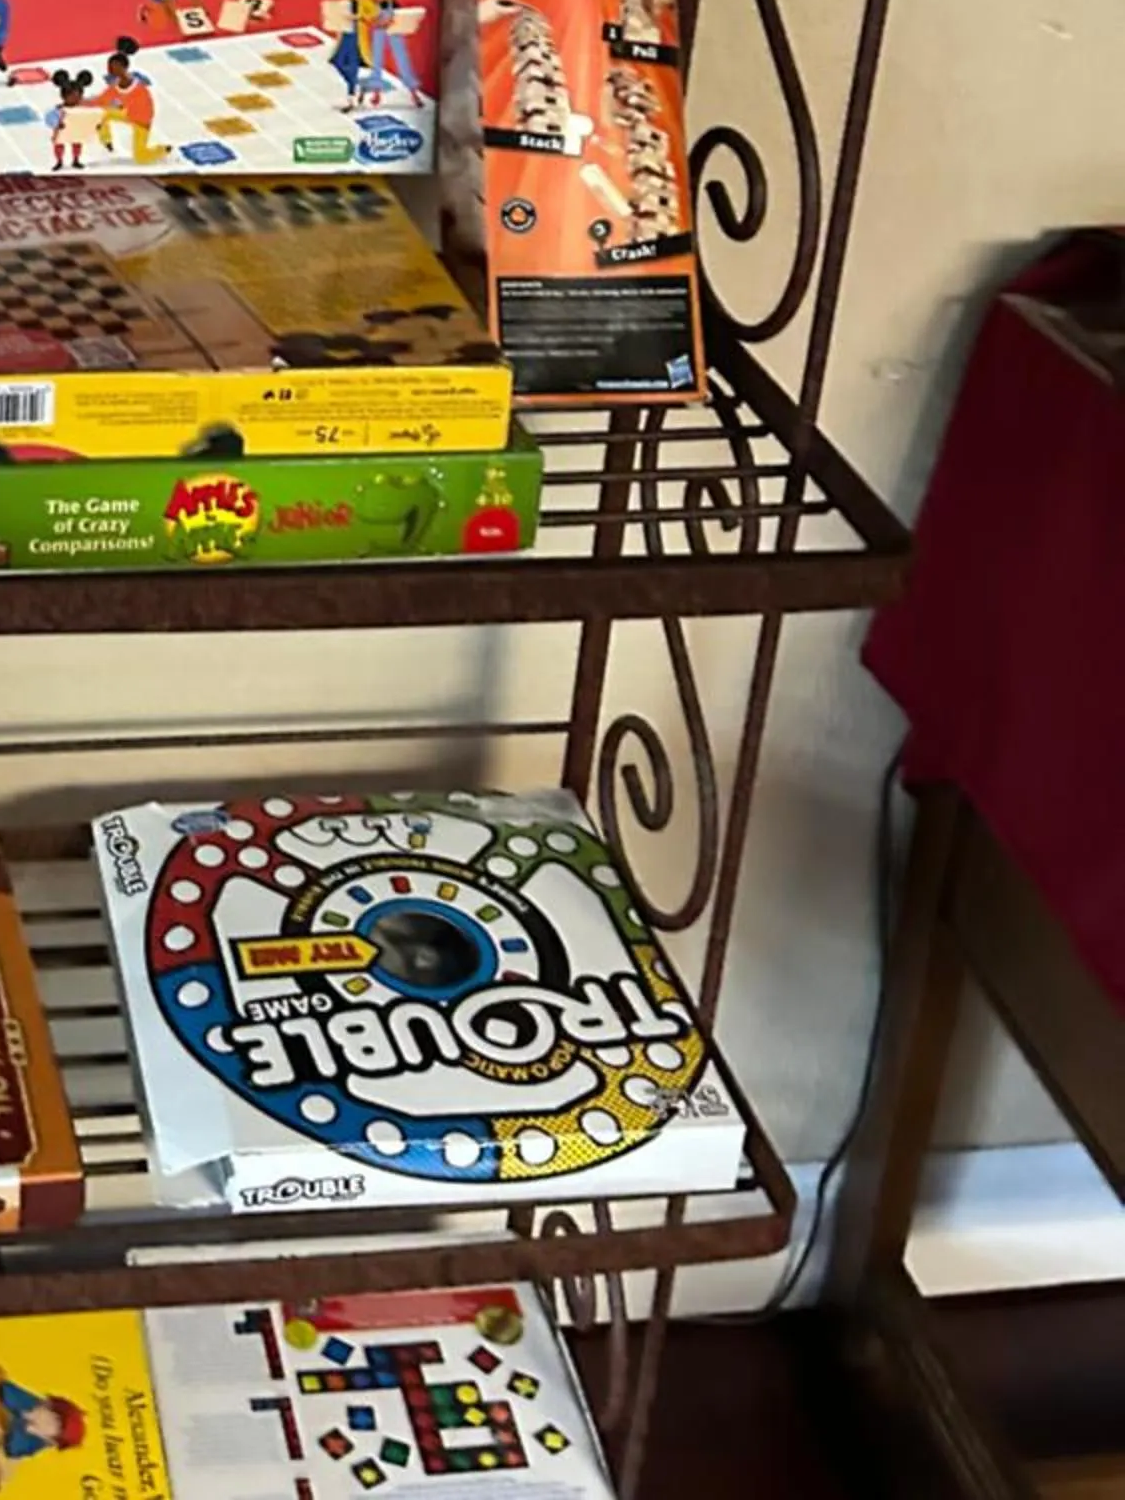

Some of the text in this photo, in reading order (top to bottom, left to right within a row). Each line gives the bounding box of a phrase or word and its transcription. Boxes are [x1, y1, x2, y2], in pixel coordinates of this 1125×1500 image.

[45, 498, 140, 515] The Game
[53, 517, 131, 535] of Crazy
[28, 533, 156, 555] Comparisons!
[248, 993, 333, 1022] GAME
[232, 977, 680, 1088] TROUBLE
[239, 1174, 366, 1207] TROUBLE
